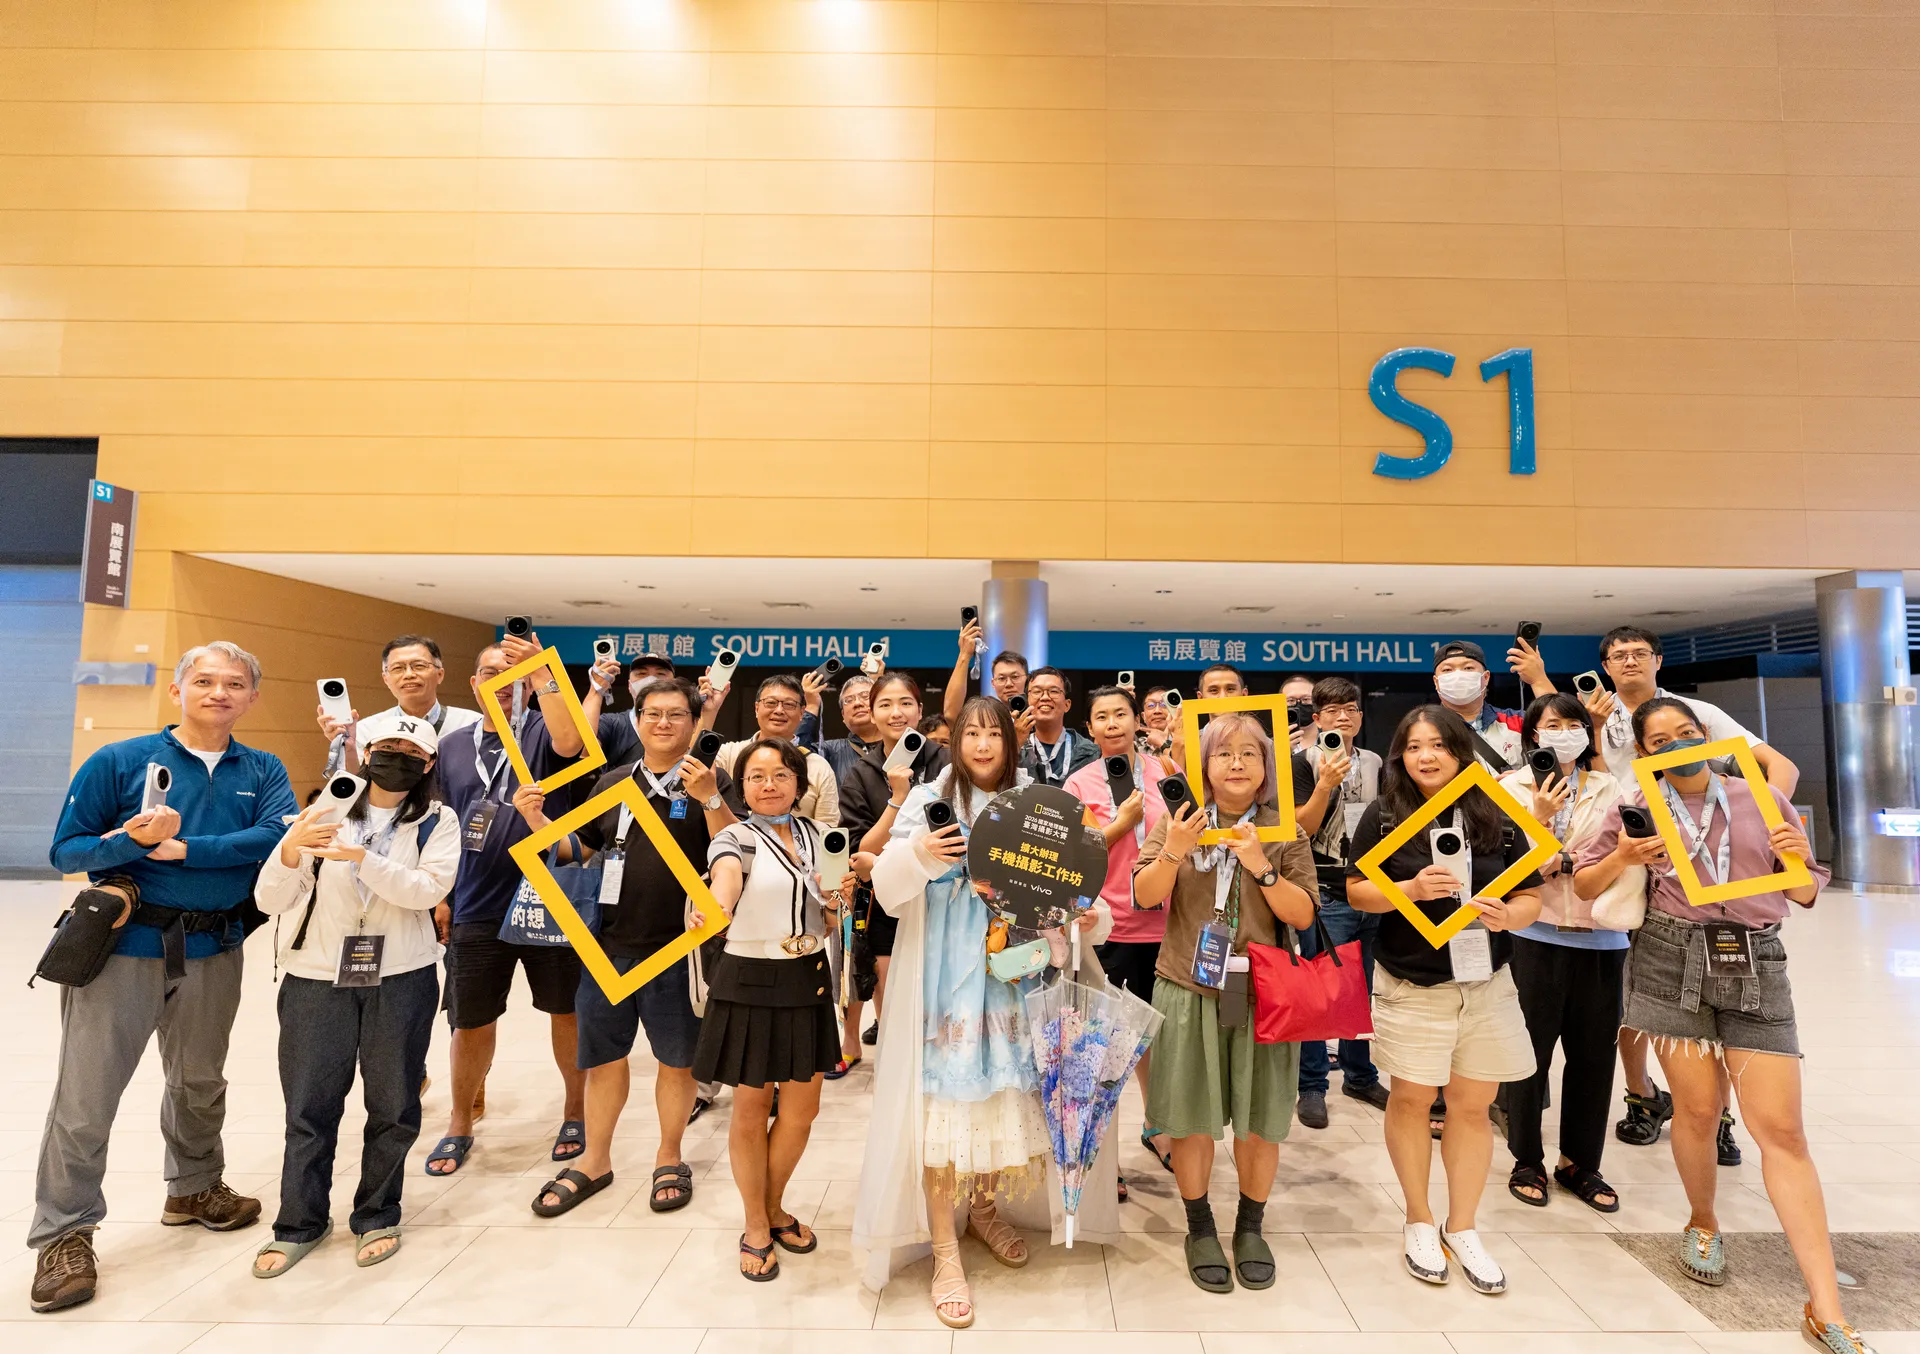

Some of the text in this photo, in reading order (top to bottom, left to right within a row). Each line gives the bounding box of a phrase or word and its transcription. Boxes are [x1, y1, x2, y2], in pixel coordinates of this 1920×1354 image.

[1368, 347, 1536, 480] S1
[95, 484, 112, 499] S1
[710, 634, 801, 658] SOUTH
[805, 636, 865, 658] HALL
[1148, 638, 1247, 663] 南展覽館
[1262, 640, 1348, 663] SOUTH
[1356, 641, 1423, 663] HALL
[397, 721, 419, 734] N
[1025, 815, 1037, 823] 2026
[1020, 842, 1059, 862] 擴大辦理
[988, 847, 1084, 887] 手機攝影工作坊
[1030, 885, 1052, 895] vivo
